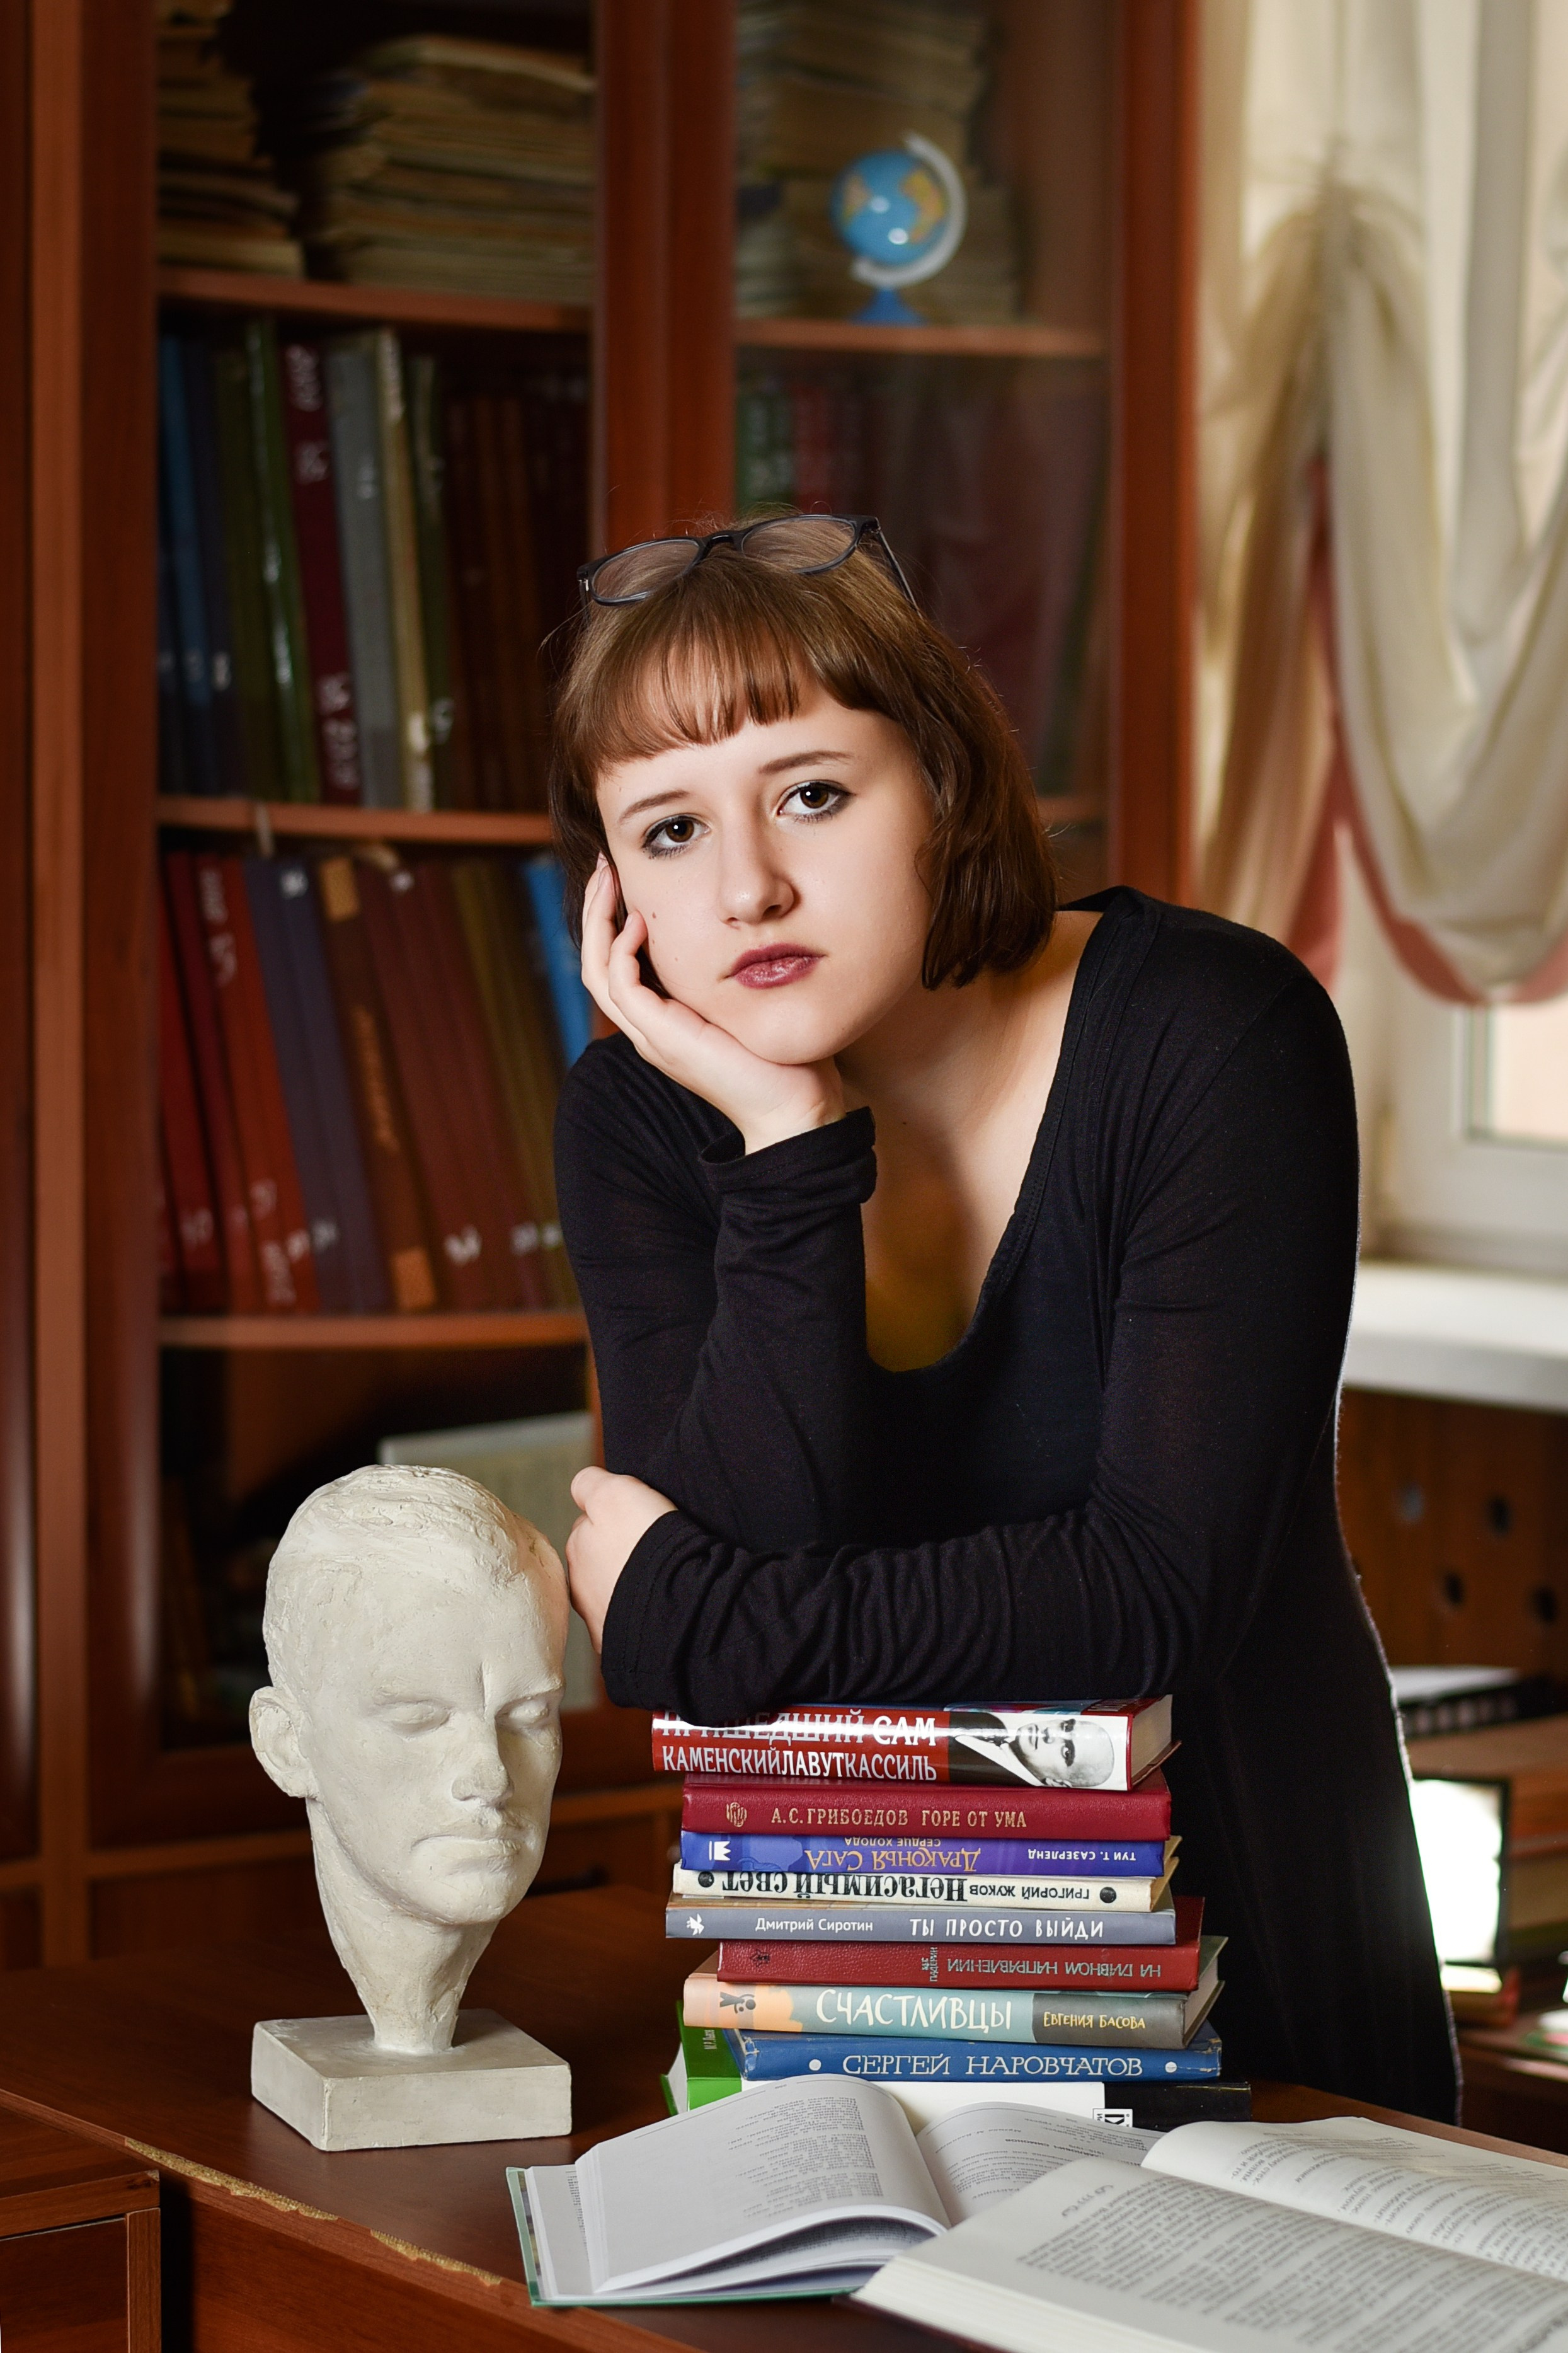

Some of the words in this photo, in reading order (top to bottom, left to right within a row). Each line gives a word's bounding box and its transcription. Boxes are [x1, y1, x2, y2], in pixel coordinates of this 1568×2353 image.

[872, 1715, 936, 1746] САМ
[922, 1809, 960, 1827] ГОРЕ
[967, 1810, 989, 1827] ОТ
[995, 1810, 1027, 1828] УМА
[844, 1837, 893, 1847] ХОЛОДА
[896, 1838, 941, 1847] СЕРДЦЕ
[804, 1849, 863, 1871] САГА
[873, 1848, 981, 1872] ДРАКОНЬЯ
[1027, 1848, 1096, 1861] САЗЕРЛЕНД
[1100, 1851, 1109, 1861] Т.
[1113, 1851, 1136, 1861] ТУИ
[722, 1872, 789, 1893] свет
[793, 1872, 968, 1902] Негасимый
[969, 1884, 1016, 1897] ЖУКОВ
[1021, 1885, 1090, 1901] ГРИГОРИЙ
[755, 1917, 815, 1932] Дмитрий
[818, 1918, 874, 1933] Сиротин
[909, 1918, 936, 1937] ТЫ
[945, 1918, 1023, 1938] ПРОСТО
[1034, 1916, 1104, 1941] ВЫЙДИ
[946, 1957, 1058, 1976] НАПРАВЛЕНИИ
[1065, 1961, 1133, 1978] ГЛАВНОМ
[1140, 1964, 1161, 1978] НА
[816, 1989, 1012, 2034] СЧАСТЛИВЦЫ
[1043, 2011, 1094, 2029] ЕВГЕНИЯ
[1099, 2011, 1146, 2030] БАСОВА
[842, 2053, 951, 2075] СЕРГЕЙ
[965, 2055, 1143, 2076] НАРОВЧАТОВ
